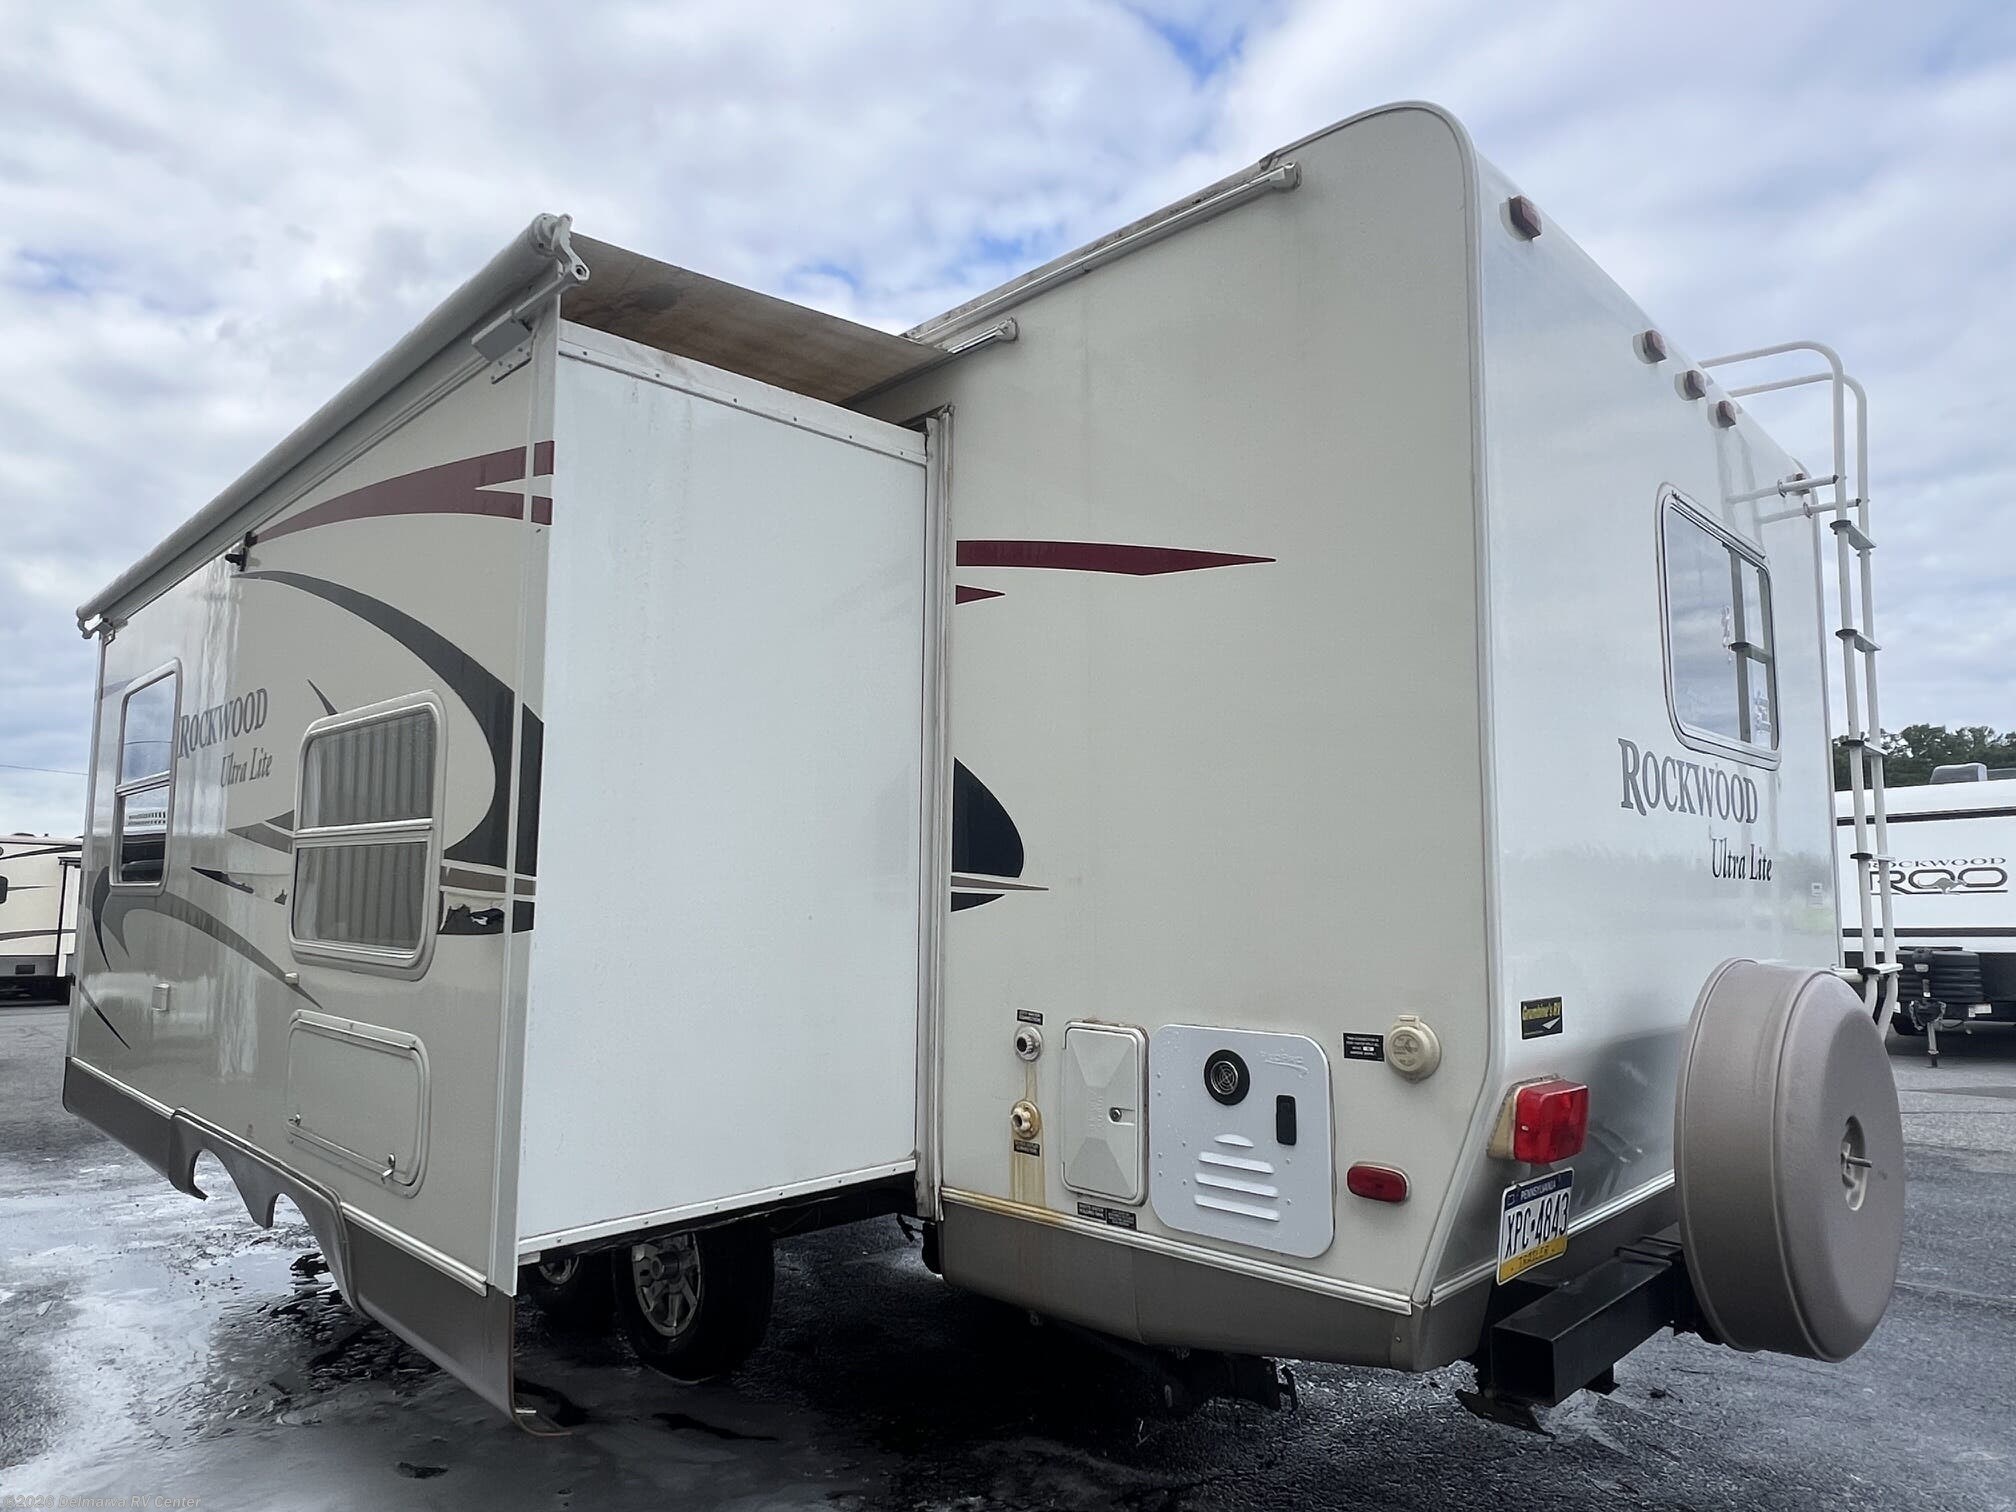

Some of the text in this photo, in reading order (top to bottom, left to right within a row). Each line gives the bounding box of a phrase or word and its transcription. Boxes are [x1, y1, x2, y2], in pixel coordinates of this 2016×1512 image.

[177, 688, 268, 759] ROCKWOOD
[220, 747, 273, 787] Ultra Lite
[1618, 738, 1758, 824] ROCKWOOD
[1711, 837, 1773, 881] Ultra Lite
